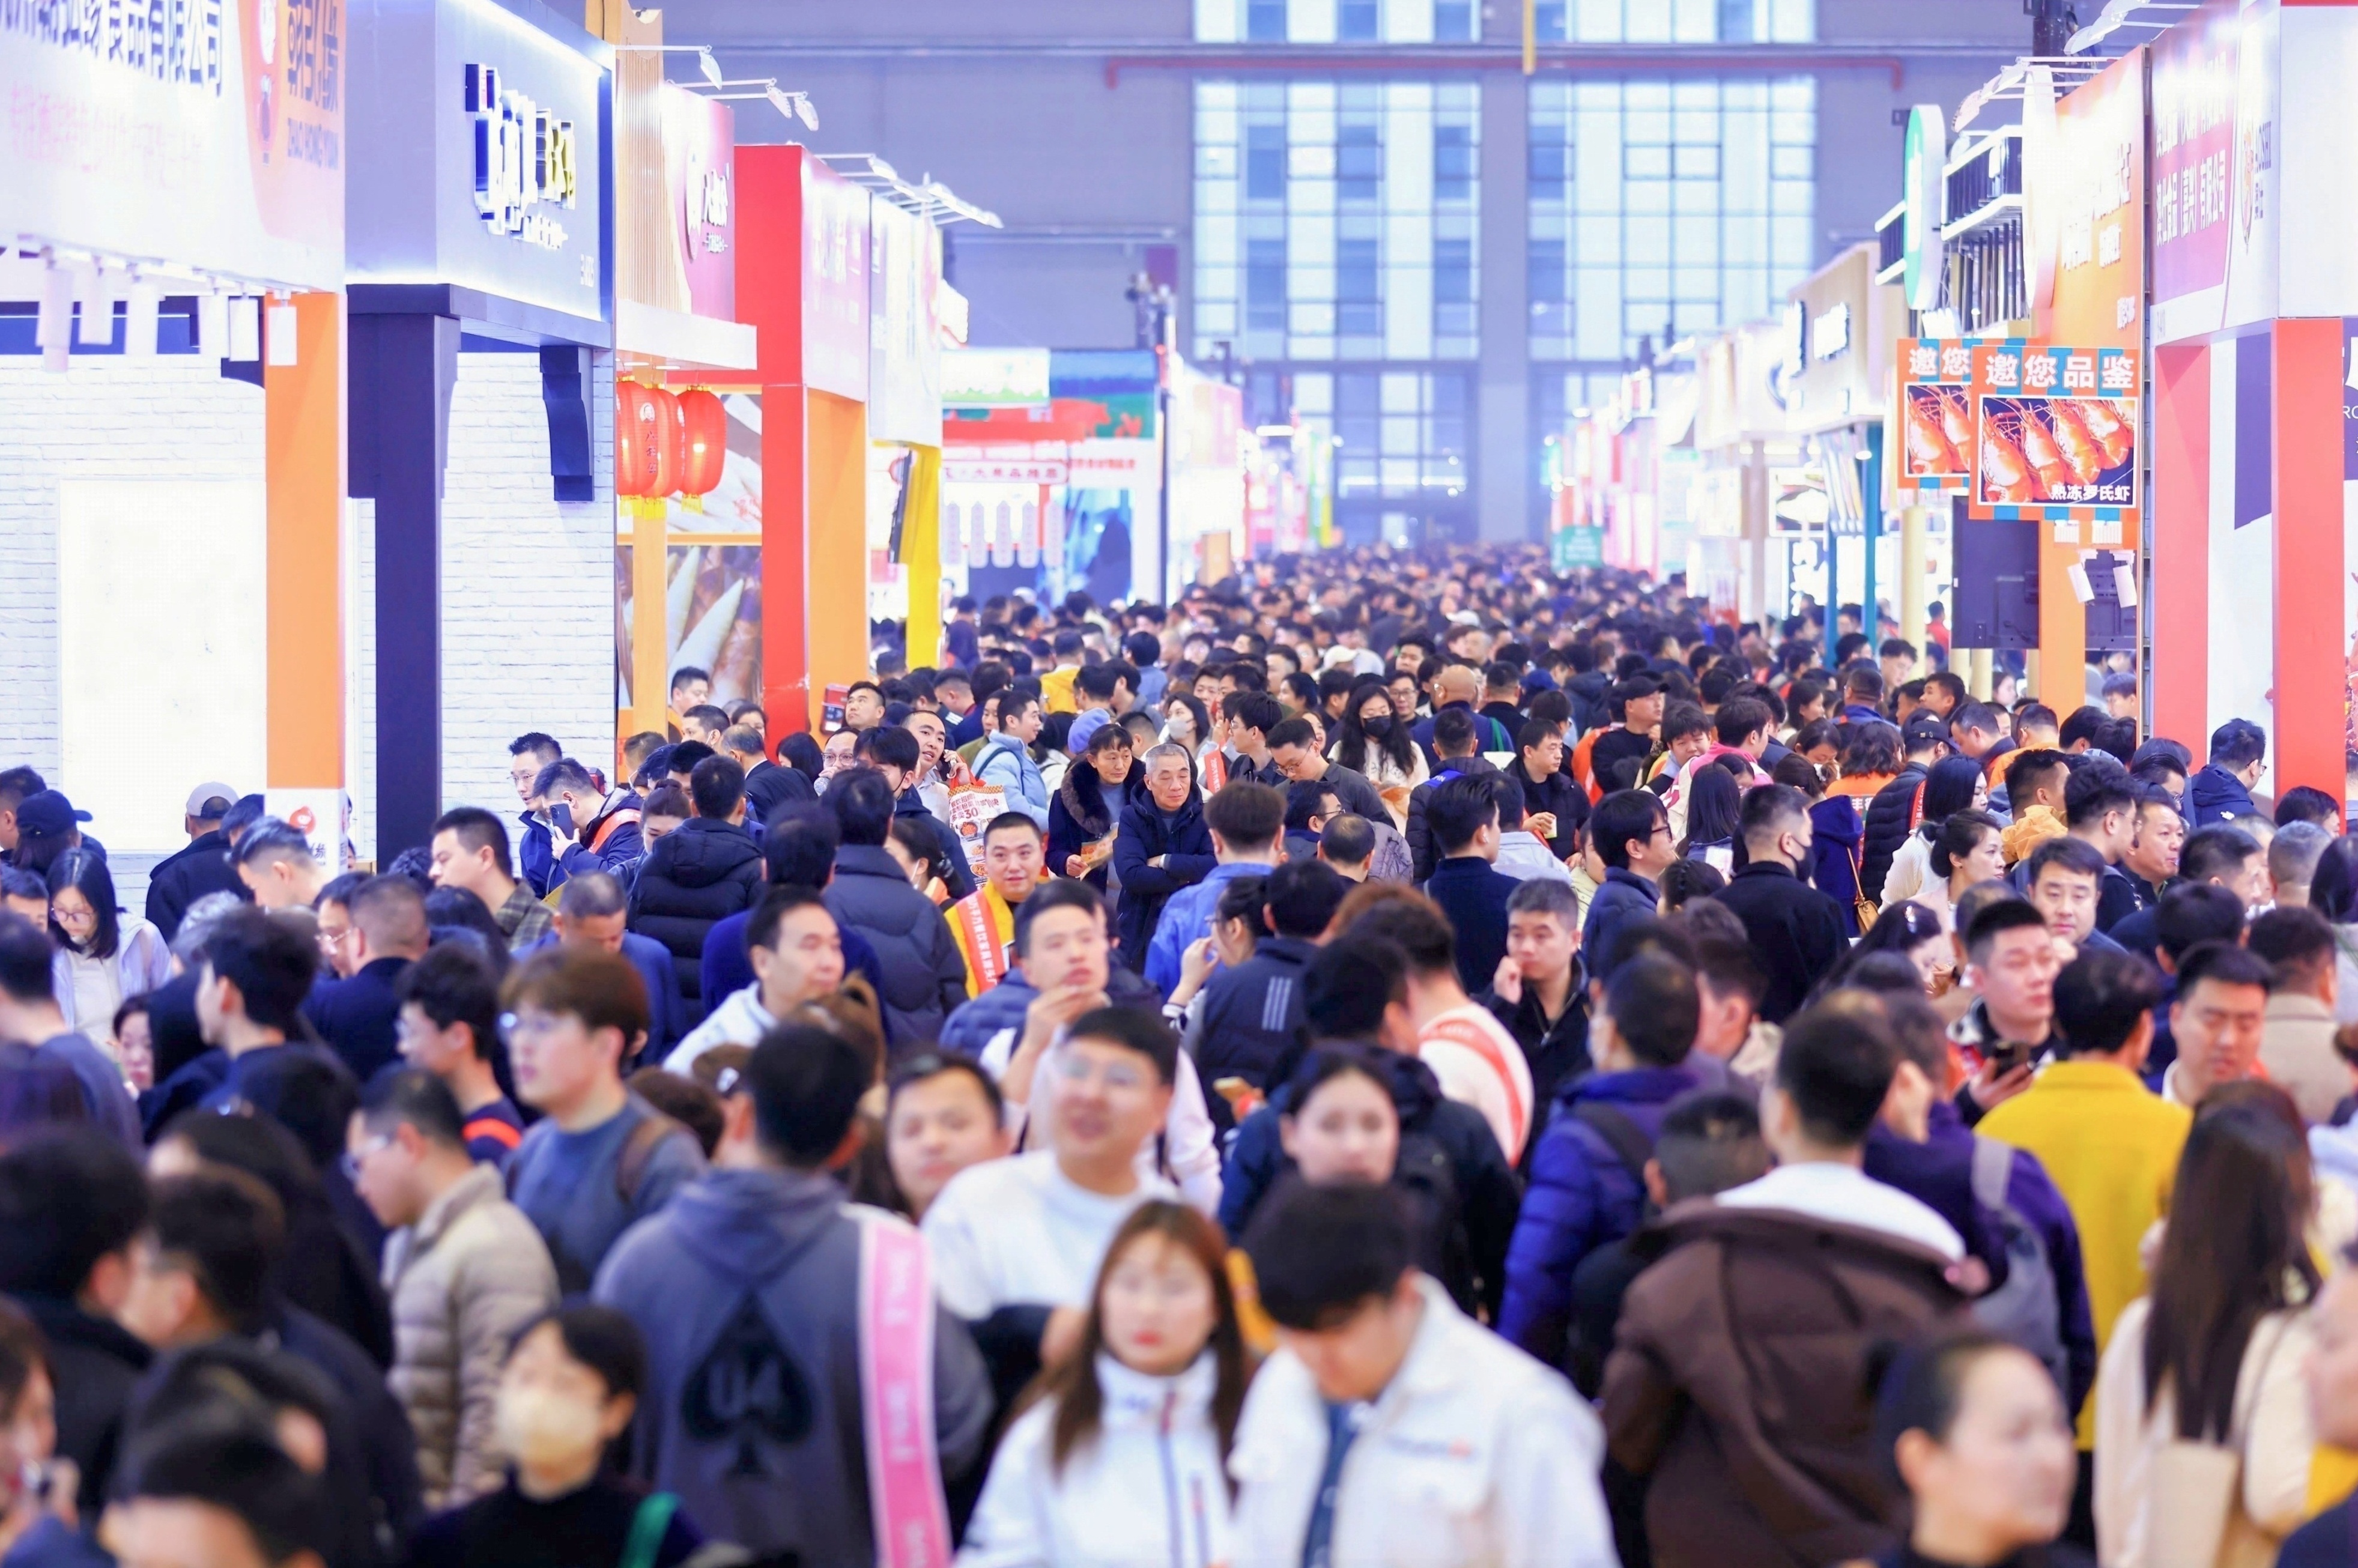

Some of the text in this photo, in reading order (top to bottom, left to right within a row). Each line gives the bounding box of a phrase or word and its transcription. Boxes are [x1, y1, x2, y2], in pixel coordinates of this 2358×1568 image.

[1909, 347, 1971, 376] 邀您
[1986, 354, 2135, 390] 邀您品鉴
